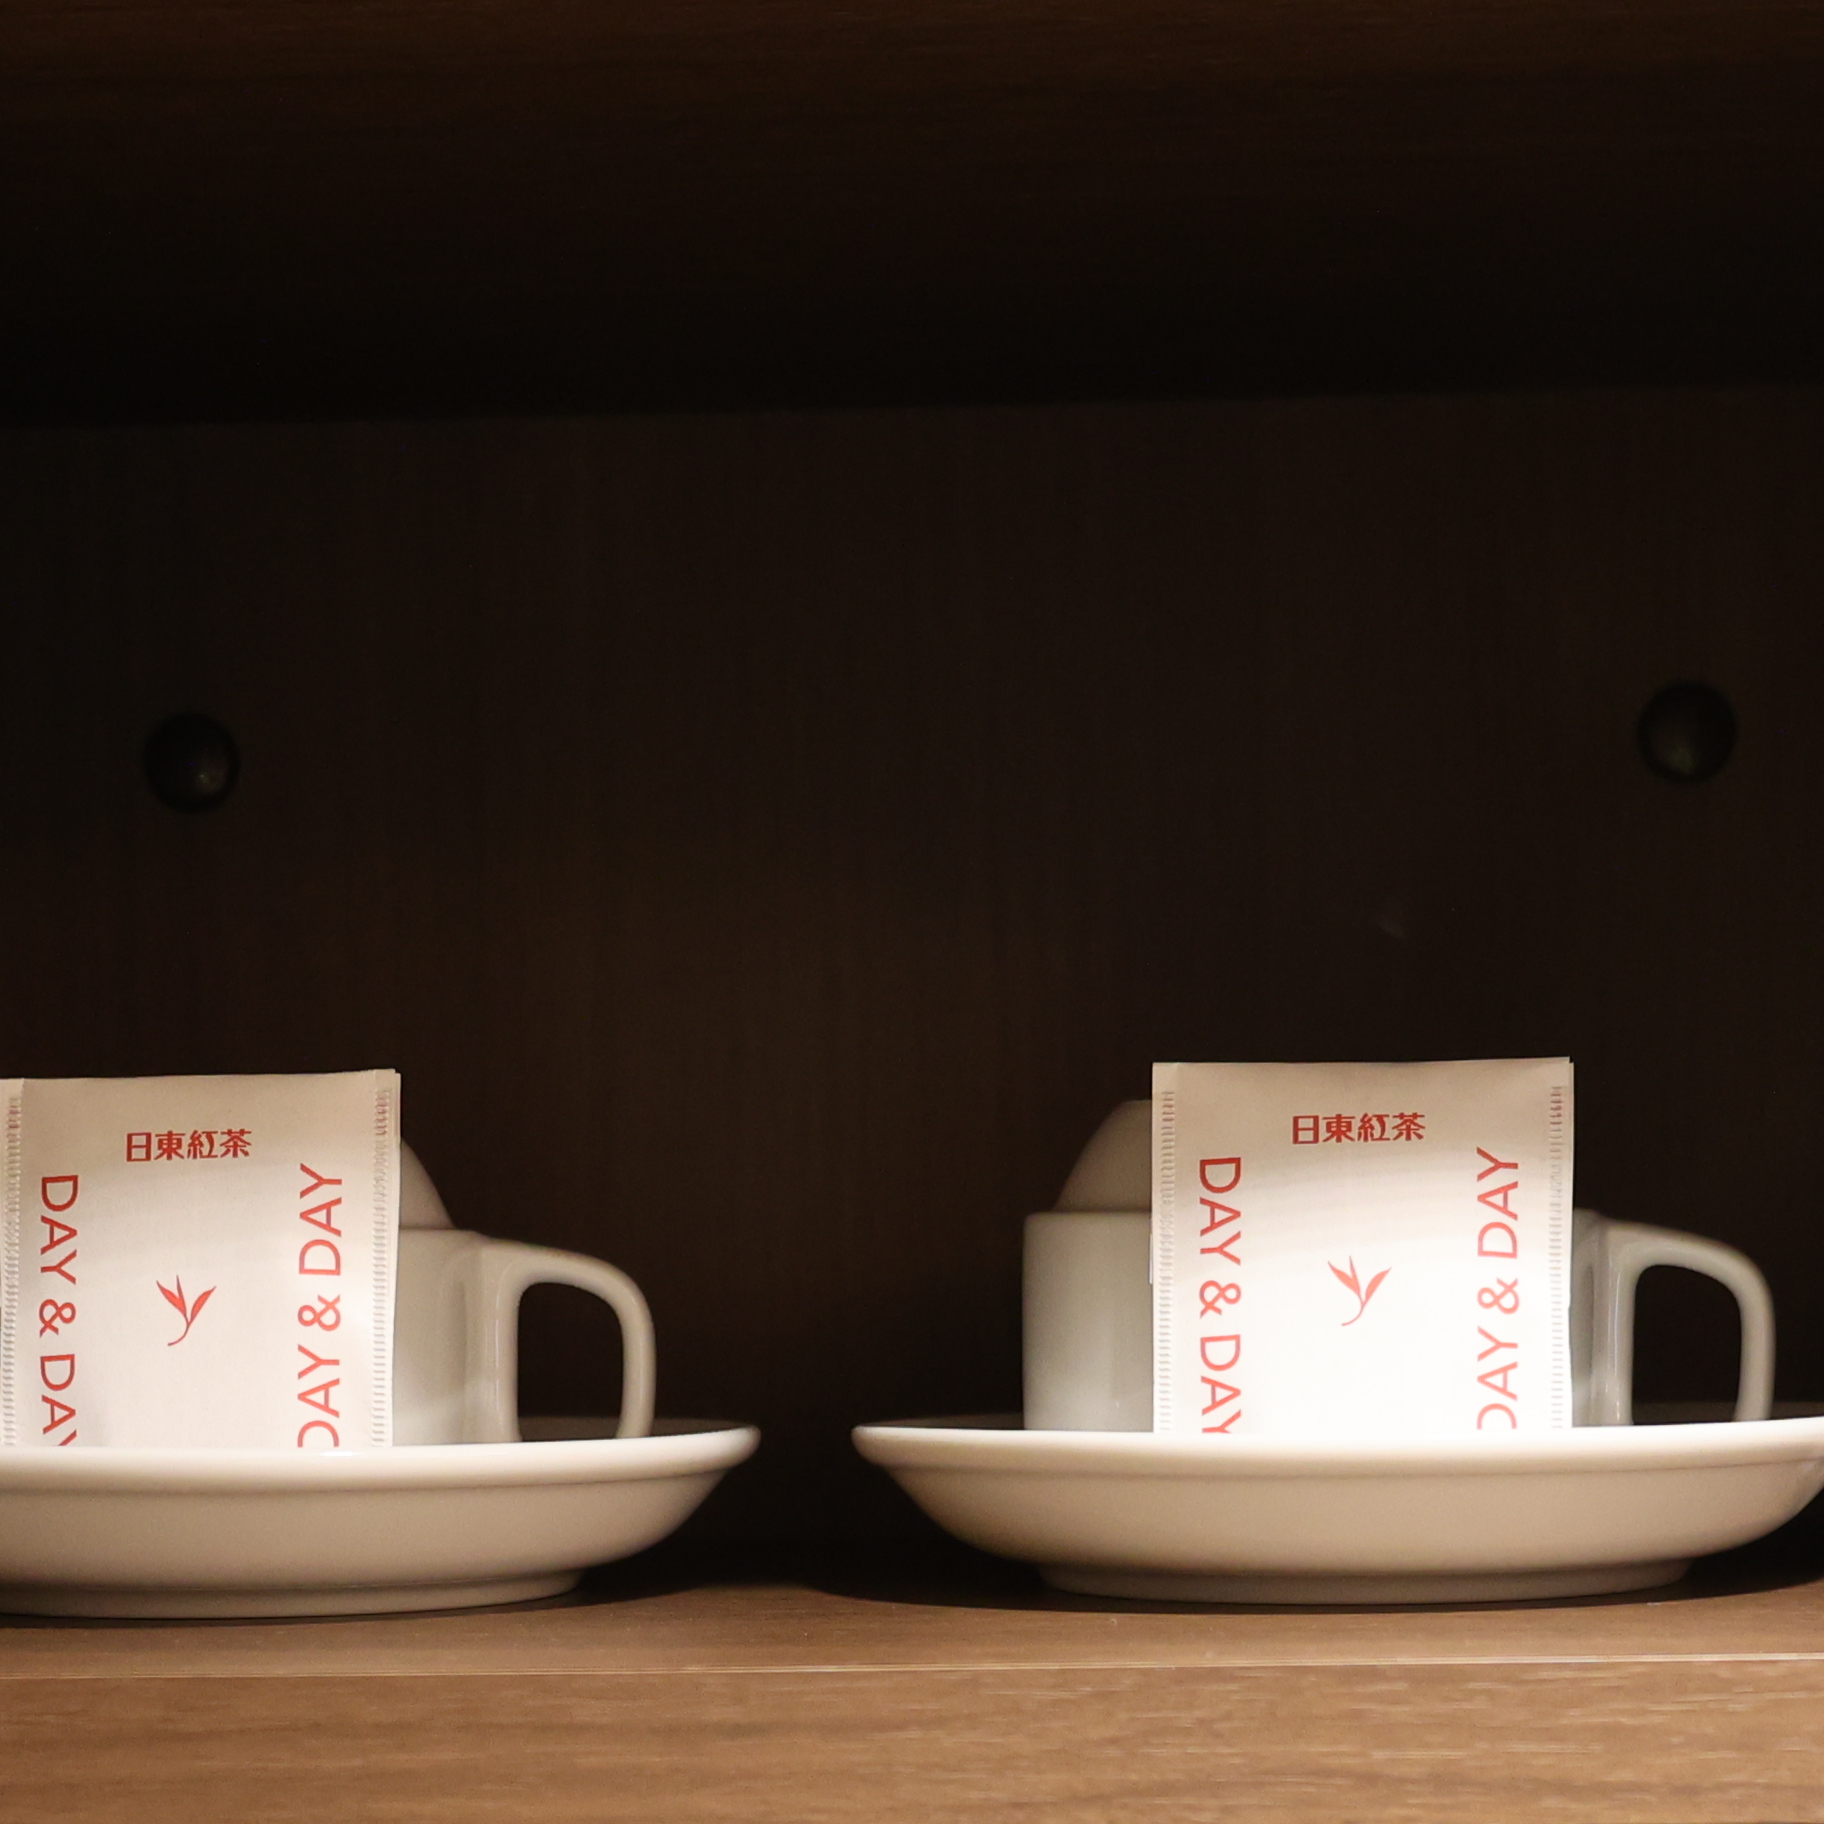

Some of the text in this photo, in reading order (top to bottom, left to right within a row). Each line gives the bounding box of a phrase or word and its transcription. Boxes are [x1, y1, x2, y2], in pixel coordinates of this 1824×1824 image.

[125, 1128, 252, 1163] 日東紅茶
[1292, 1112, 1426, 1145] 日東紅茶
[298, 1162, 343, 1276] DAY
[1199, 1156, 1242, 1267] DAY
[1476, 1146, 1519, 1260] DAY
[40, 1174, 79, 1285] DAY
[297, 1294, 341, 1332] &
[1199, 1279, 1242, 1319] &
[1476, 1277, 1520, 1315] &
[39, 1298, 77, 1338] &
